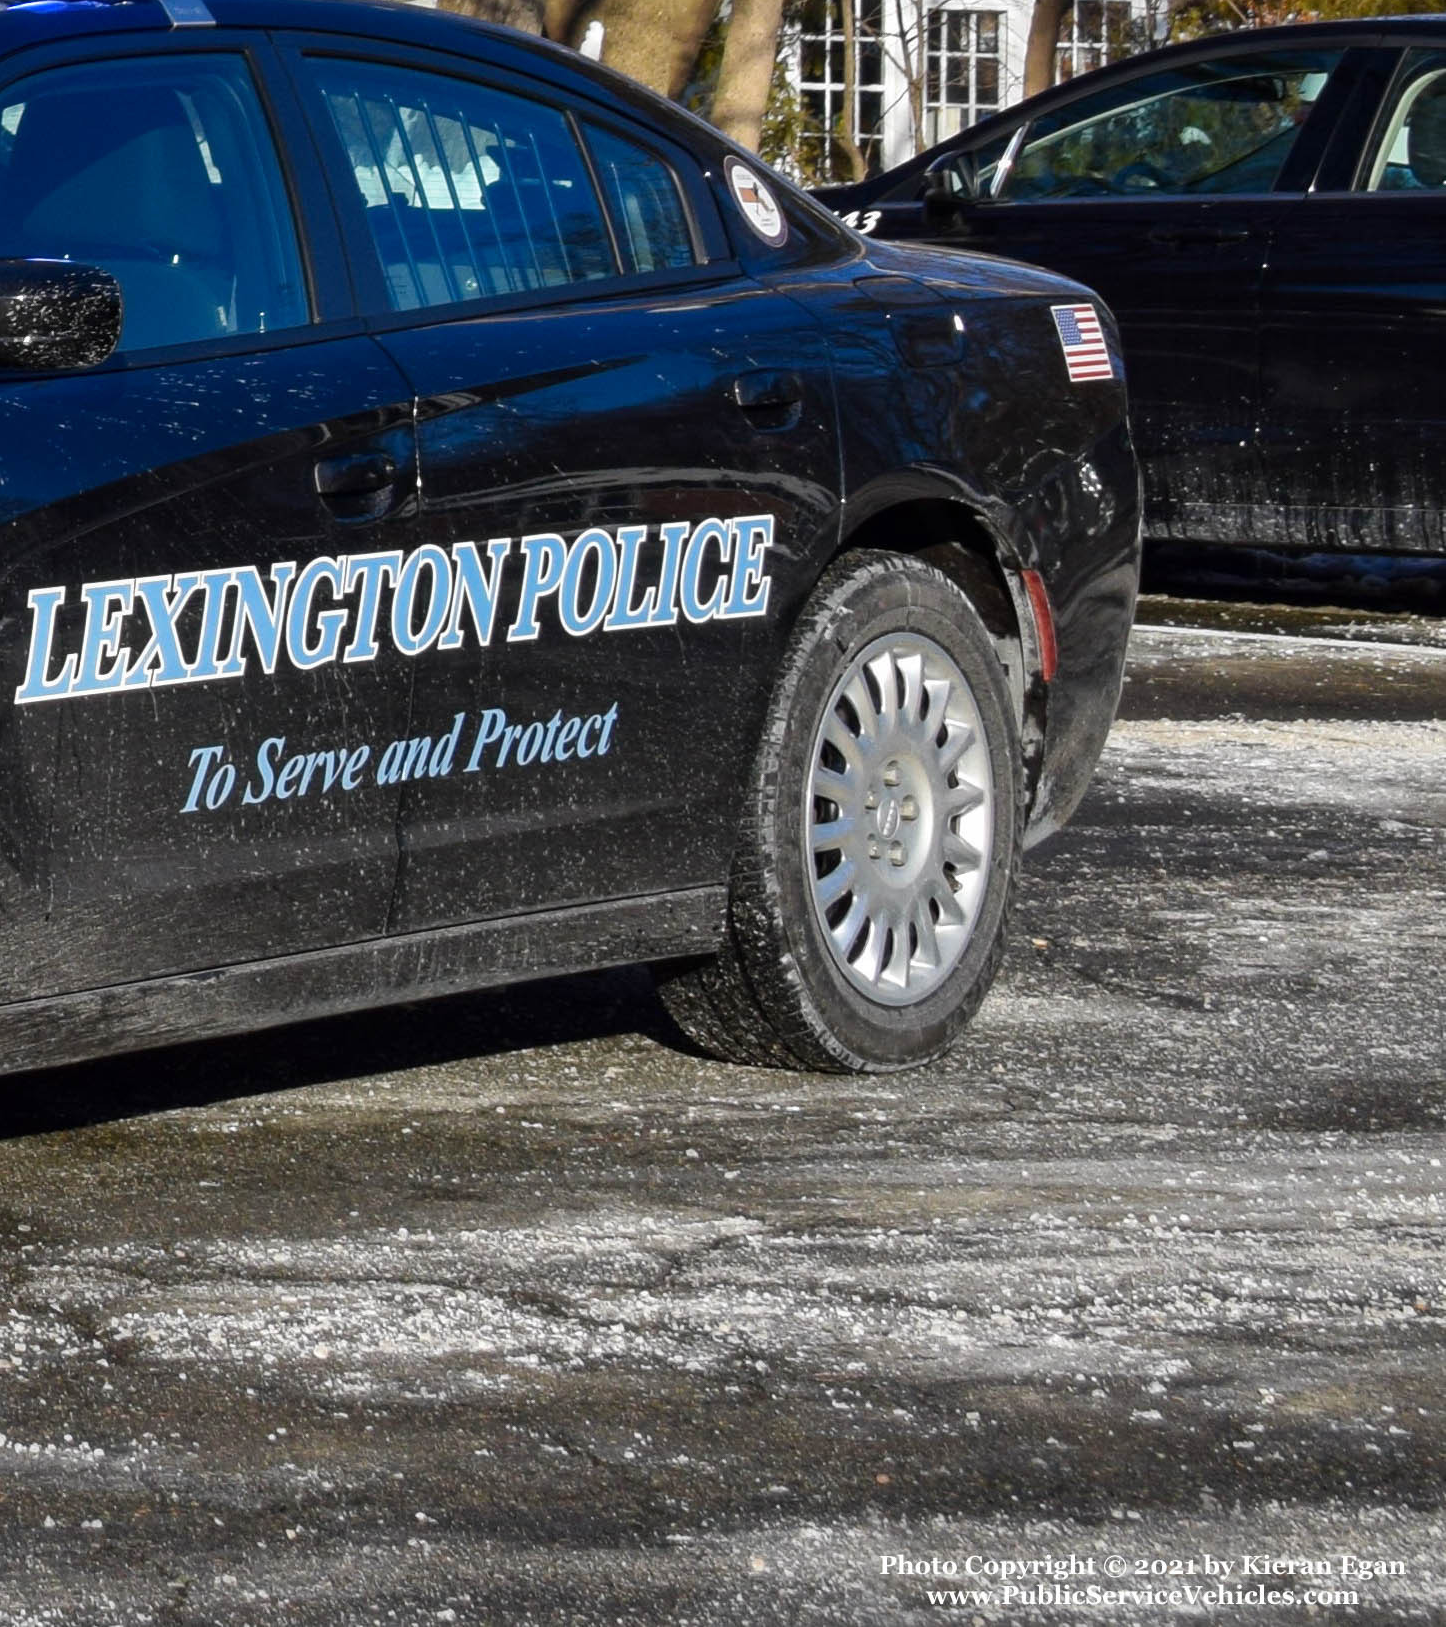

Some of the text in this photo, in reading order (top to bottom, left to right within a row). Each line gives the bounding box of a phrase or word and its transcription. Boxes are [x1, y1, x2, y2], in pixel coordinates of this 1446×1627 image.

[14, 514, 774, 704] LEXINGTON POLICE
[180, 701, 618, 813] To Serve and Protect
